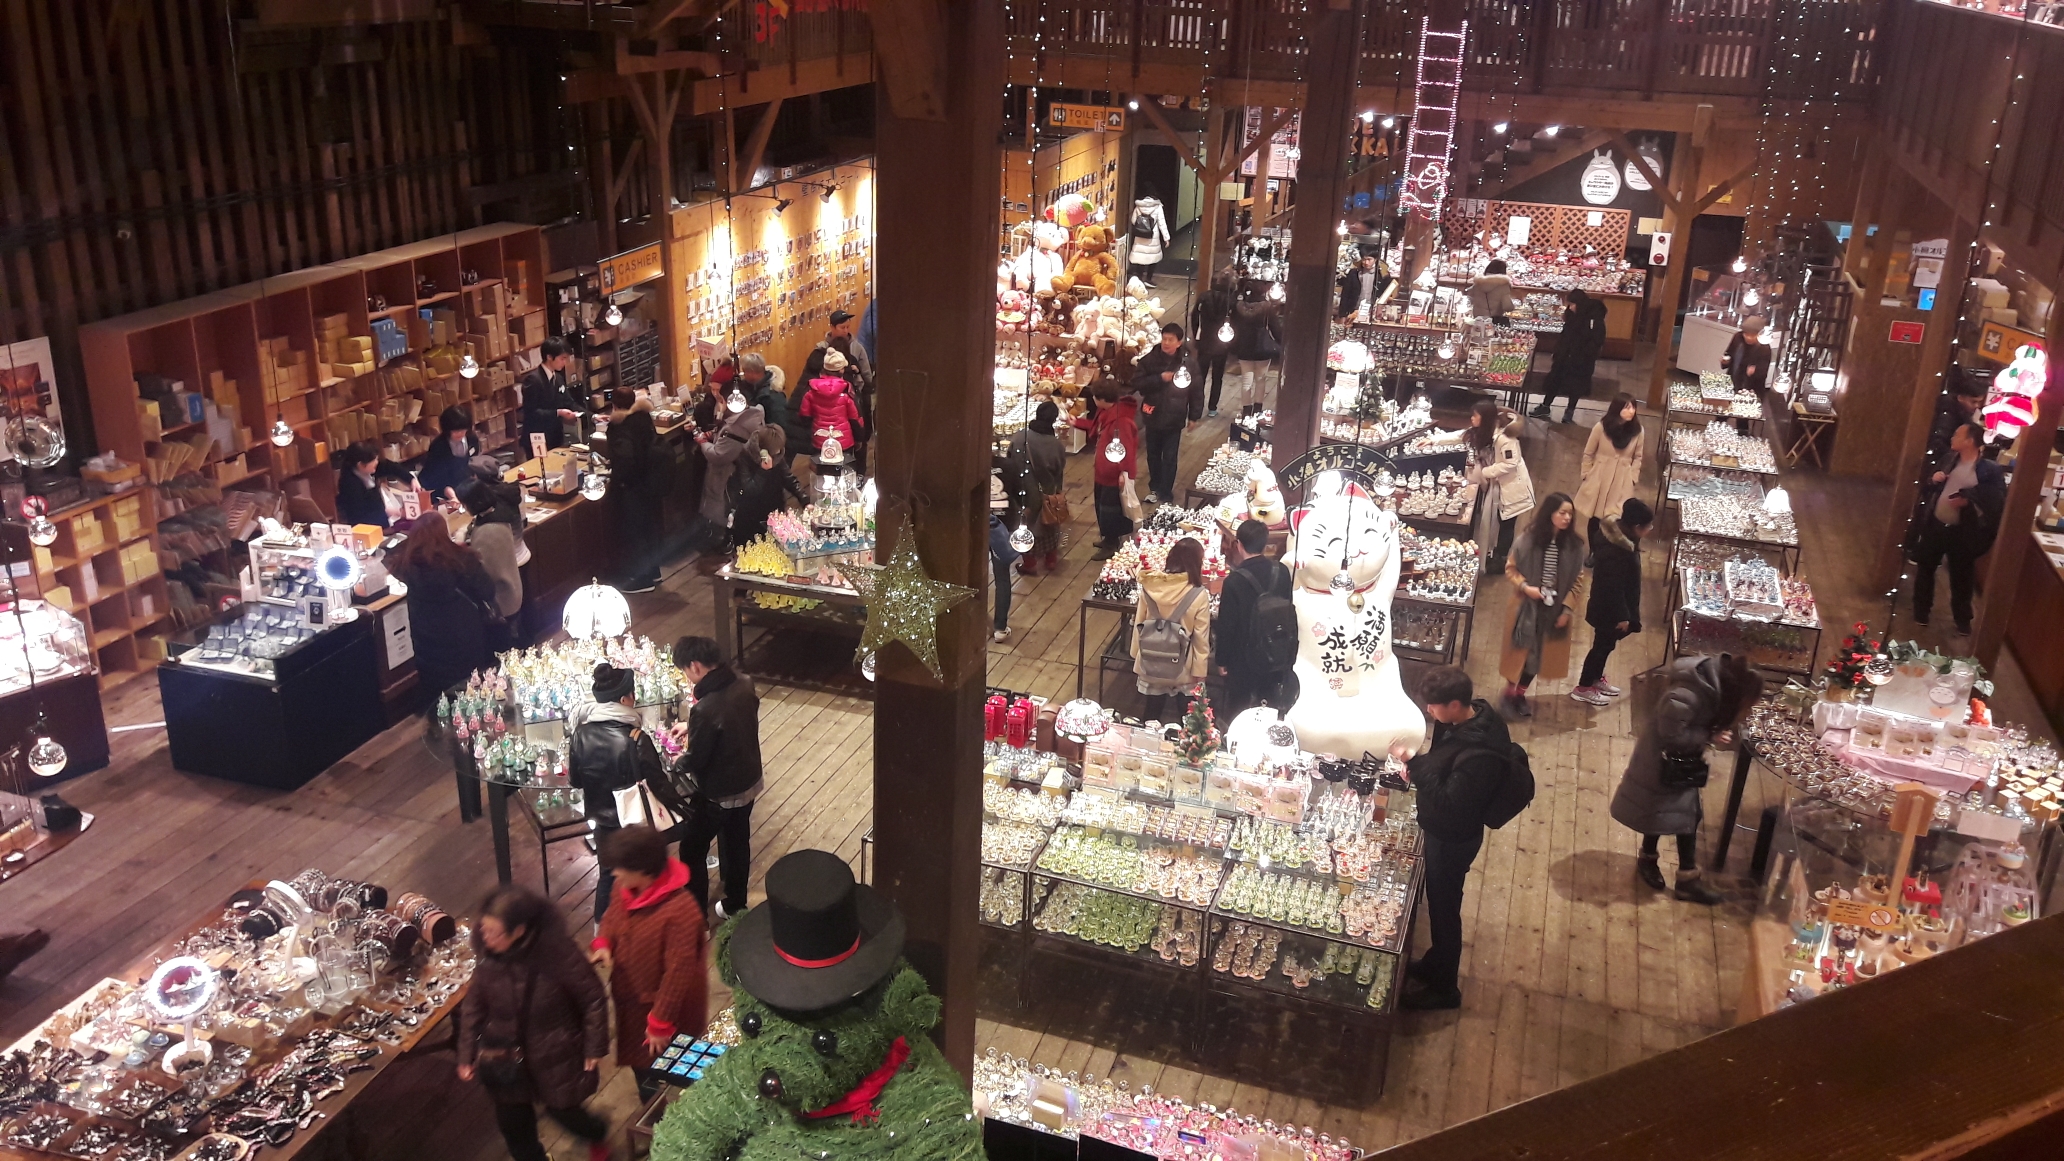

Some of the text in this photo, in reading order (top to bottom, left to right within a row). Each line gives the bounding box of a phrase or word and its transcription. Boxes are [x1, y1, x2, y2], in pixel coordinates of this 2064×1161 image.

[1069, 109, 1105, 120] TOILET
[618, 252, 658, 275] CASHIER
[536, 445, 543, 456] 1
[410, 506, 417, 518] 3
[1318, 625, 1353, 673] 成就
